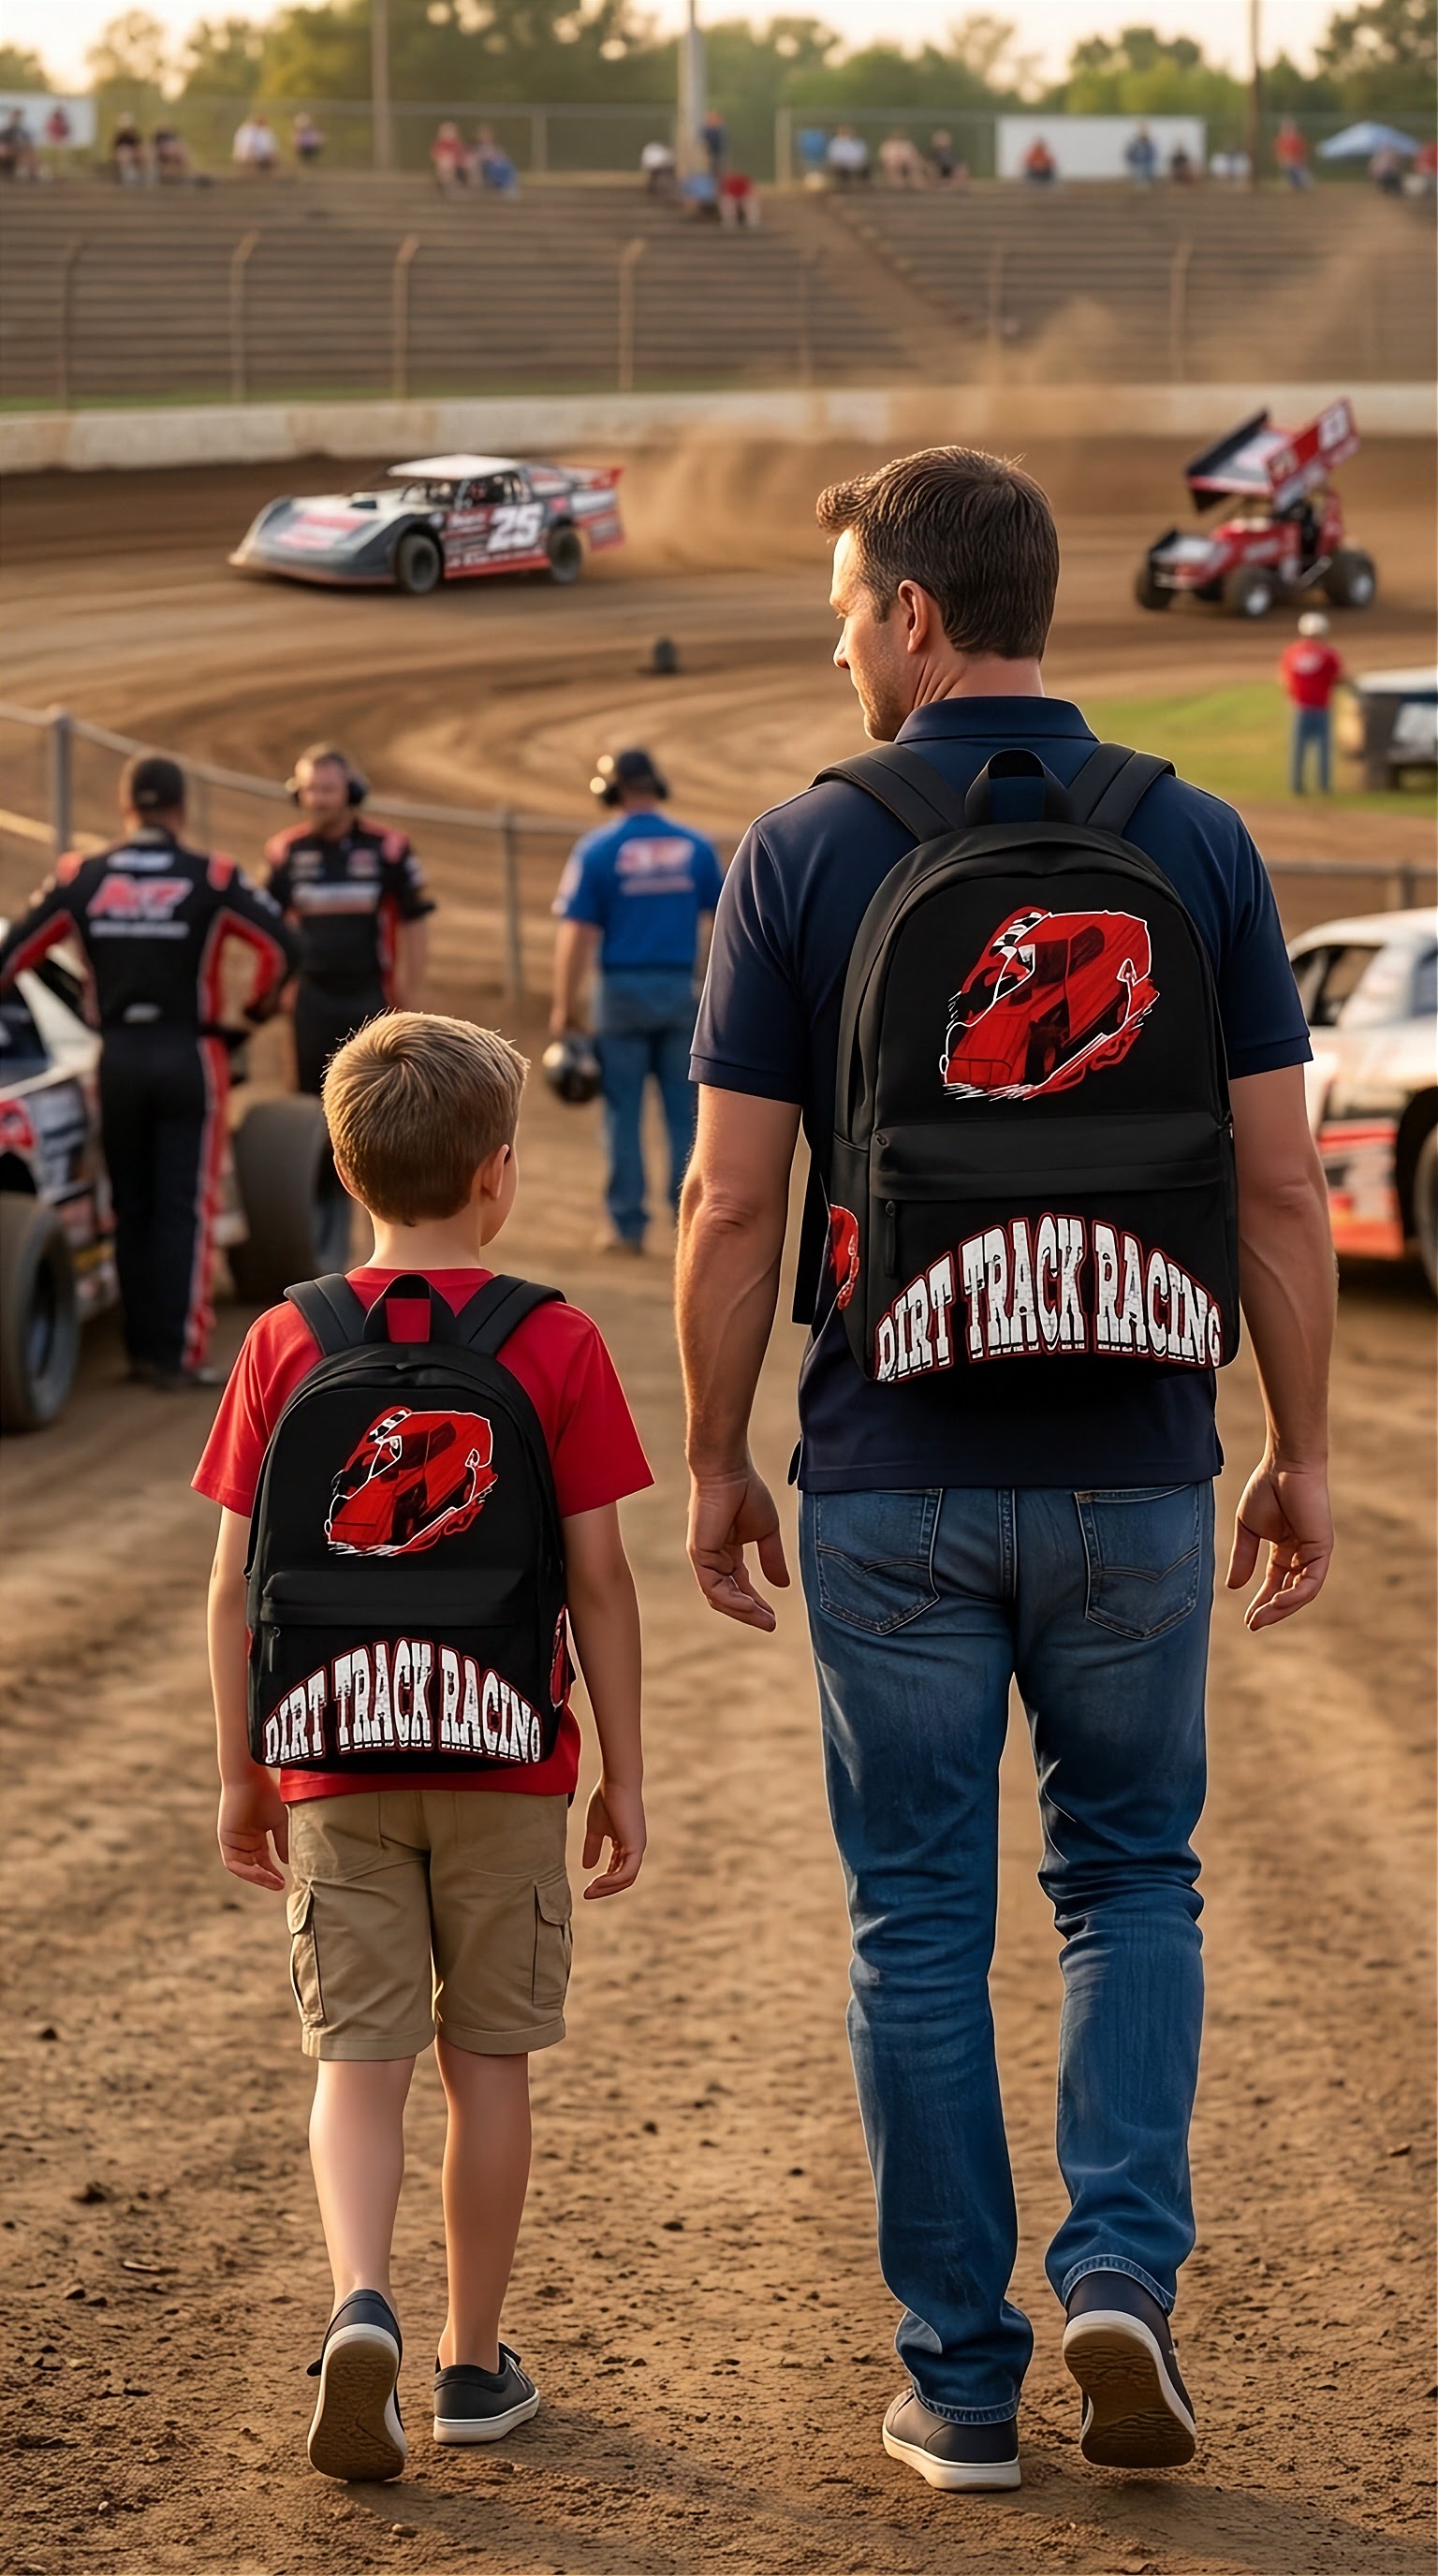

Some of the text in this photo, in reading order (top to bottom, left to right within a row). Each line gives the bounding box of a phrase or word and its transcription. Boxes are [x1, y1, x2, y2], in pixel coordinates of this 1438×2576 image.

[488, 502, 544, 552] 25
[874, 1216, 1221, 1383] DIRT TRACK RACING
[265, 1669, 328, 1764] DIRT
[333, 1639, 433, 1751] TRACK
